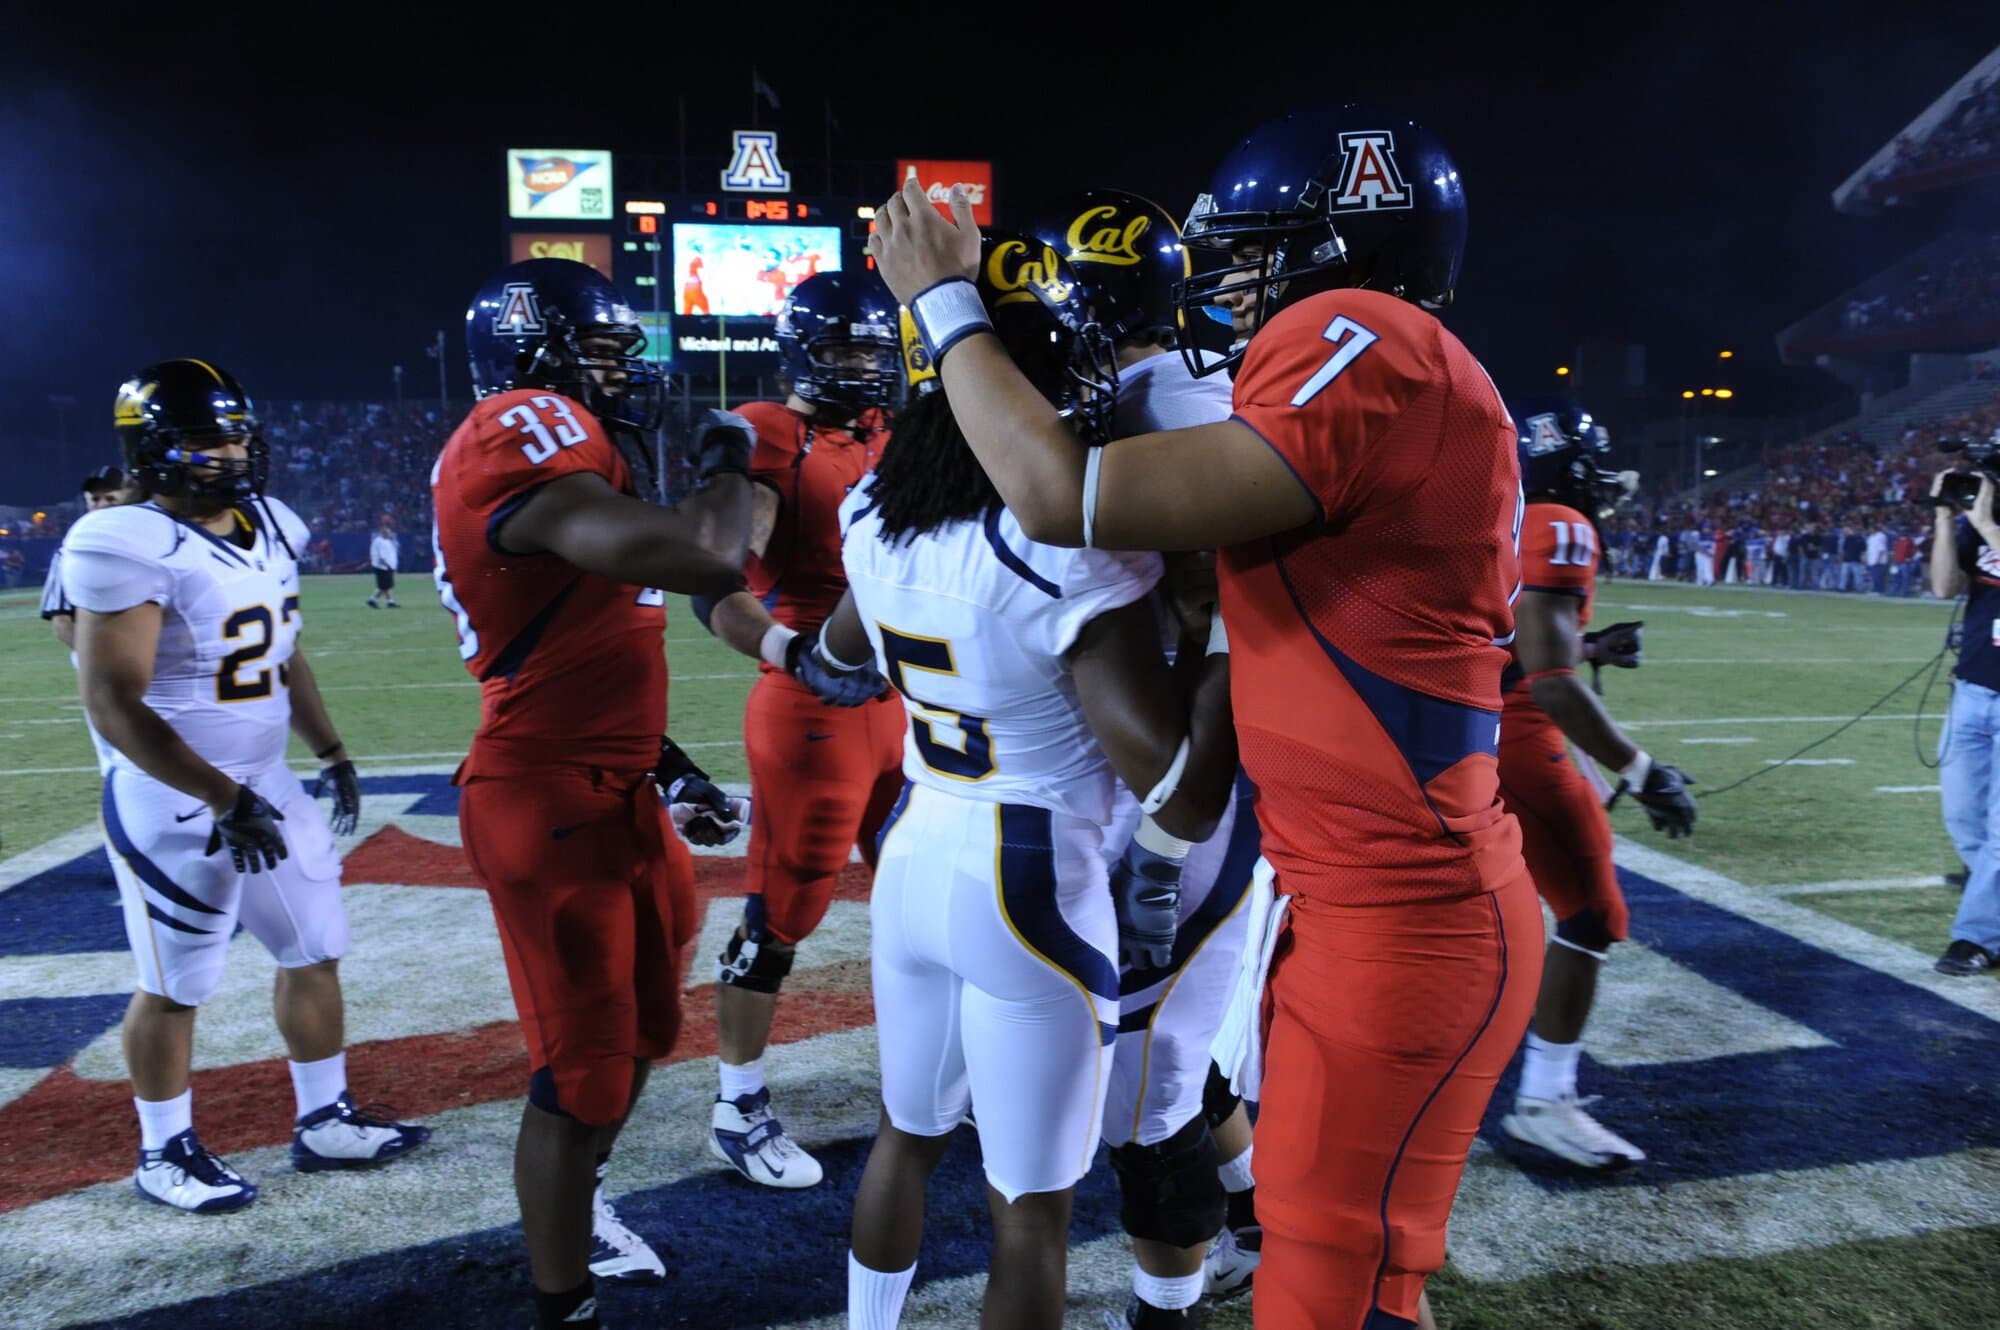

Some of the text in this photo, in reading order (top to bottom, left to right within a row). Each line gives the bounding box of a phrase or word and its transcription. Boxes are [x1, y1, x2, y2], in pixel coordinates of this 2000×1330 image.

[721, 130, 791, 192] A
[1328, 130, 1413, 214] A
[1066, 205, 1150, 266] Cal
[987, 240, 1069, 303] Cal
[1268, 248, 1285, 299] Ridell
[492, 282, 547, 335] A
[1290, 313, 1381, 407] 7
[498, 395, 589, 466] 33
[875, 619, 997, 783] 5
